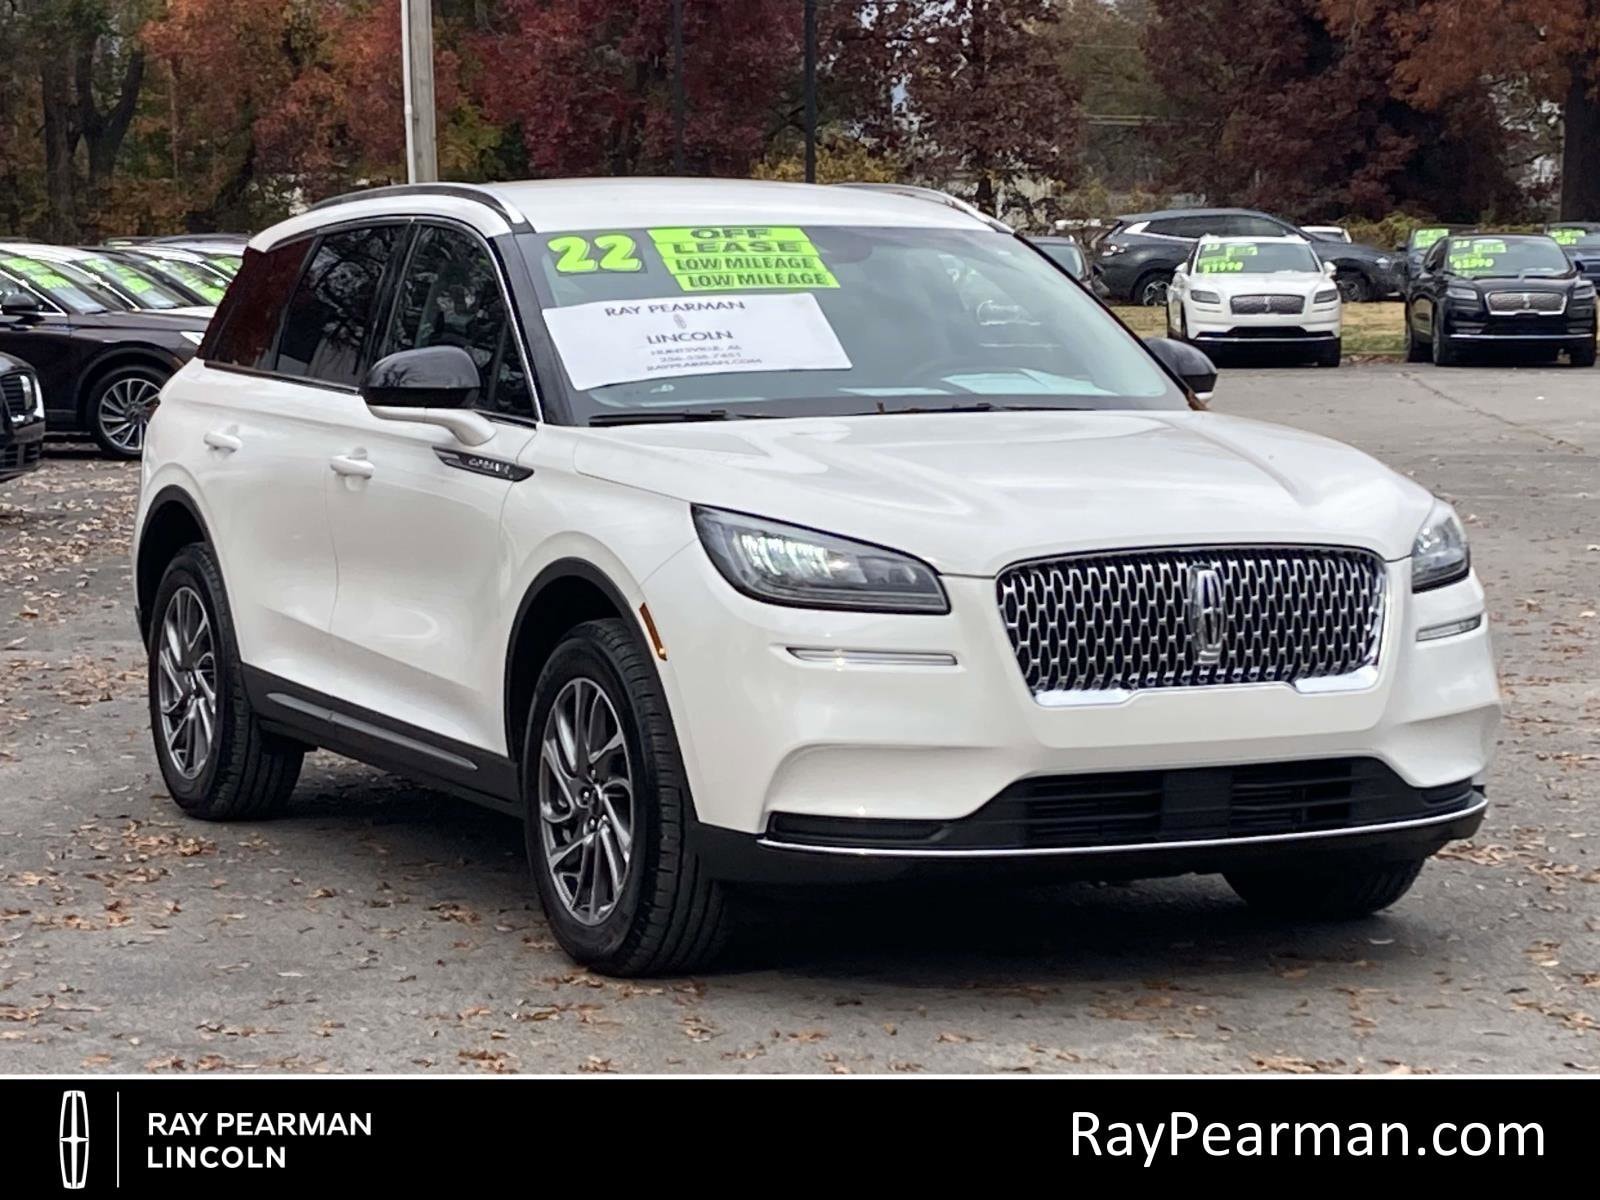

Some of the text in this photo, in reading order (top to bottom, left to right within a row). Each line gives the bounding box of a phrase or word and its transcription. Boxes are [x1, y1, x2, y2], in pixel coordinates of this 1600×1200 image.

[690, 227, 772, 240] OFF
[547, 234, 642, 273] 22
[673, 240, 802, 254] LEASE
[675, 257, 815, 271] LOW MILEAGE
[688, 273, 829, 288] LOW MILEAGE
[604, 300, 746, 317] RAY PEARMAN
[646, 330, 734, 344] LINCOLN
